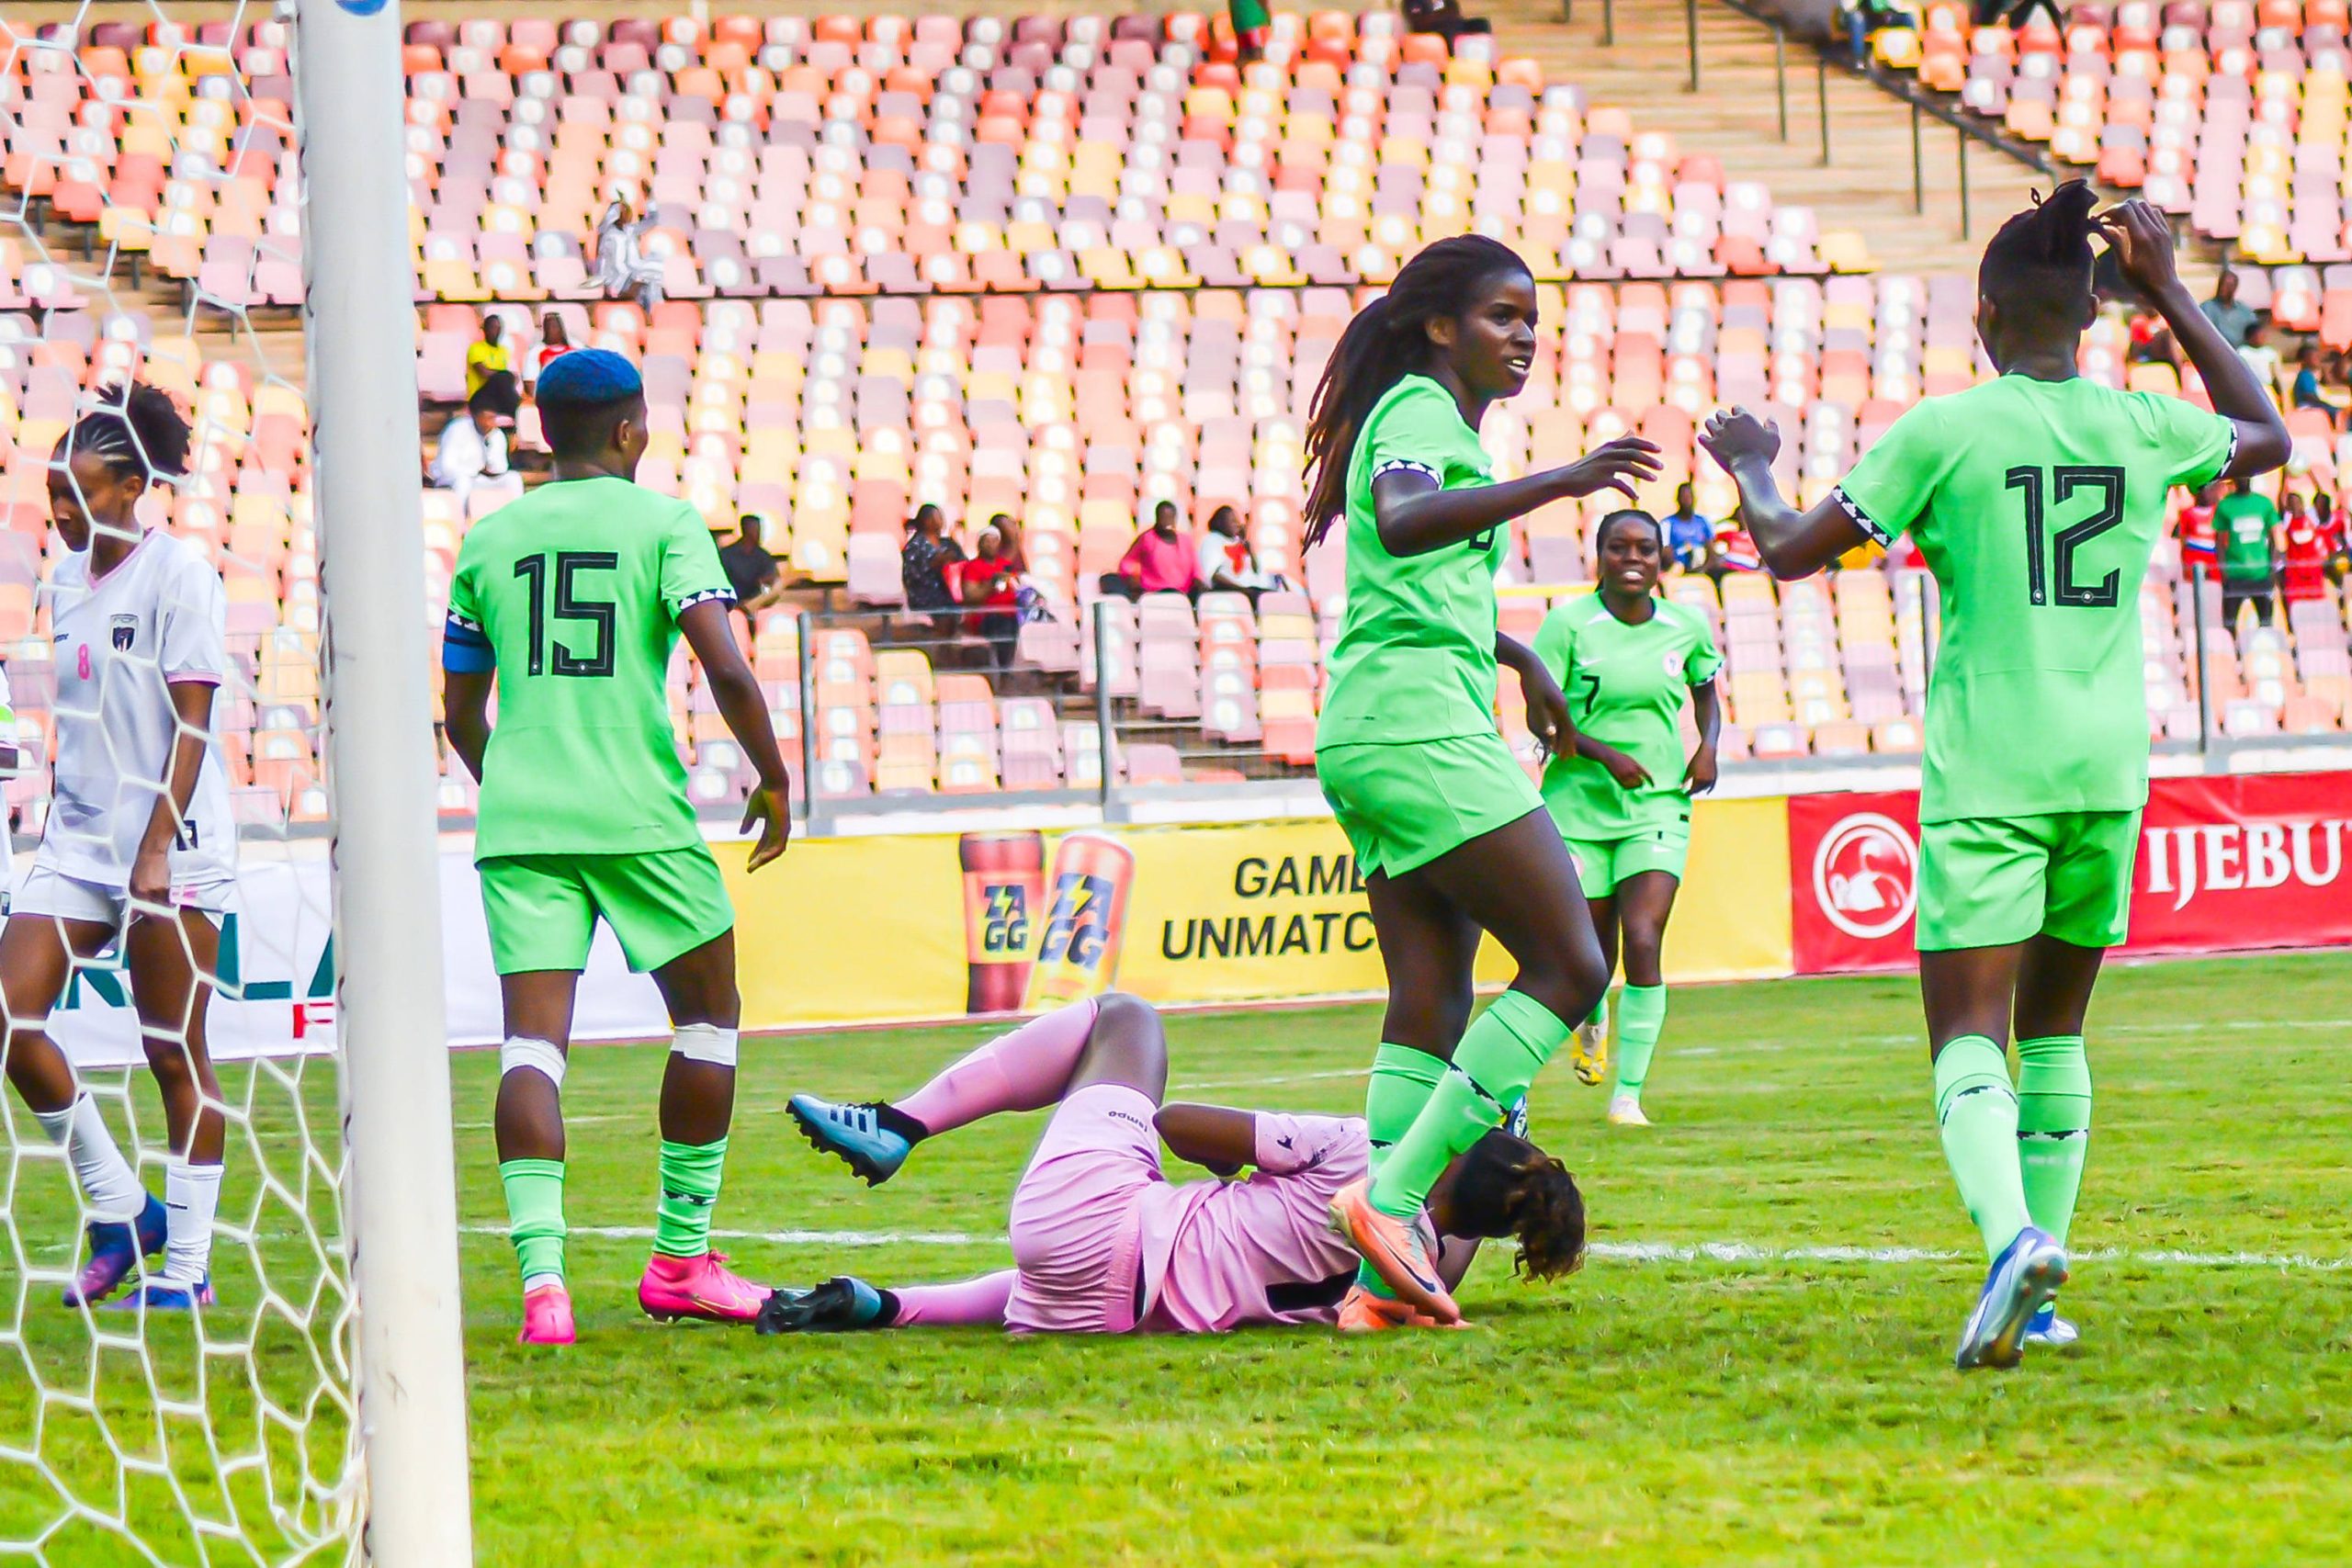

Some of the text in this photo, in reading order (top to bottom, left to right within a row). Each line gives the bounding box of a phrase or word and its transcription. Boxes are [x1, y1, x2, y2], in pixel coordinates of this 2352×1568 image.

[2006, 466, 2125, 607] 12
[514, 552, 617, 677] 15
[78, 643, 90, 680] 8
[1581, 675, 1600, 715] 7
[2144, 818, 2352, 911] IJEBU
[1162, 911, 1374, 960] UNMATC
